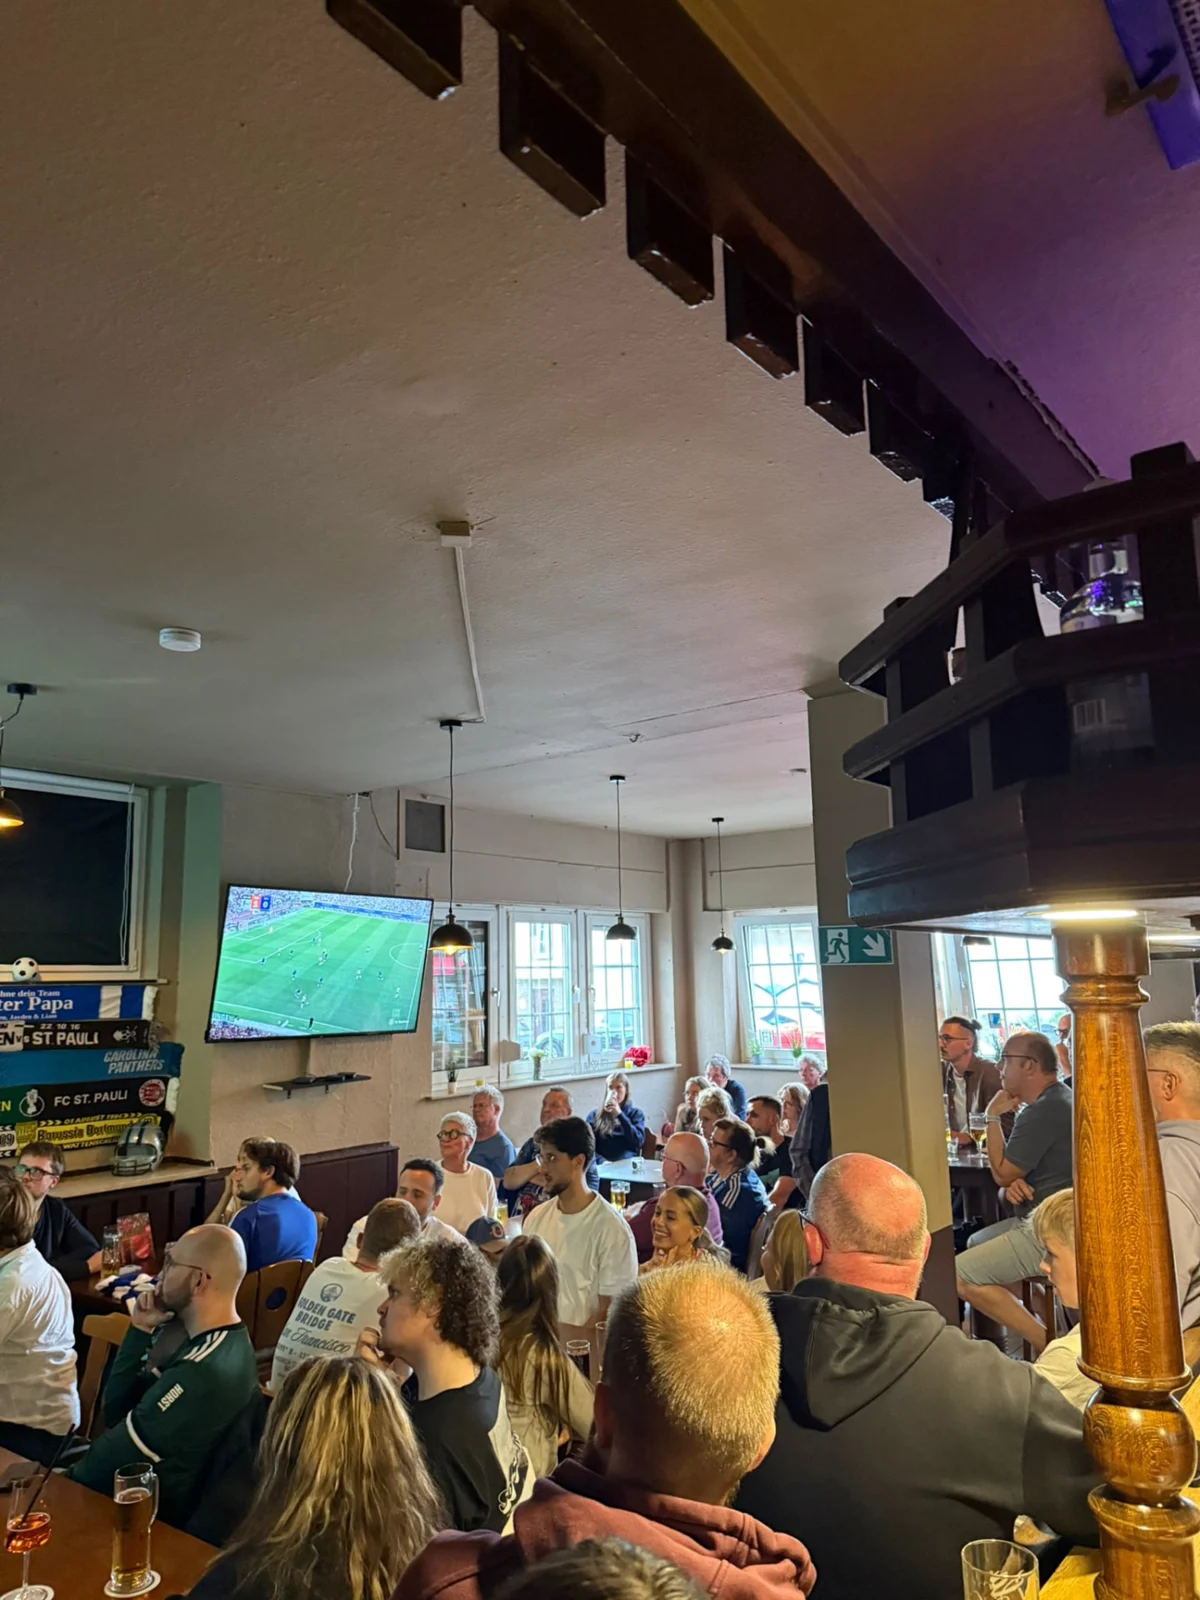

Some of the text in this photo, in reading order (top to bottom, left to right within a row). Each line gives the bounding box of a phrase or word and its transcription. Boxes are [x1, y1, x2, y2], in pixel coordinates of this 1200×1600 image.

[38, 989, 60, 997] Team
[27, 996, 73, 1014] Papa
[56, 1031, 99, 1046] PAULI
[103, 1048, 159, 1063] CAROLINA
[108, 1059, 165, 1074] PANTHERS
[54, 1095, 71, 1107] FC
[73, 1093, 91, 1105] ST.
[93, 1089, 128, 1104] PAULI
[37, 1126, 84, 1141] Borussia
[86, 1119, 133, 1137] Dortmun
[295, 1311, 333, 1331] BRIDGE
[327, 1308, 356, 1325] GATE
[291, 1327, 351, 1353] Francisco
[157, 1383, 184, 1412] HORST
